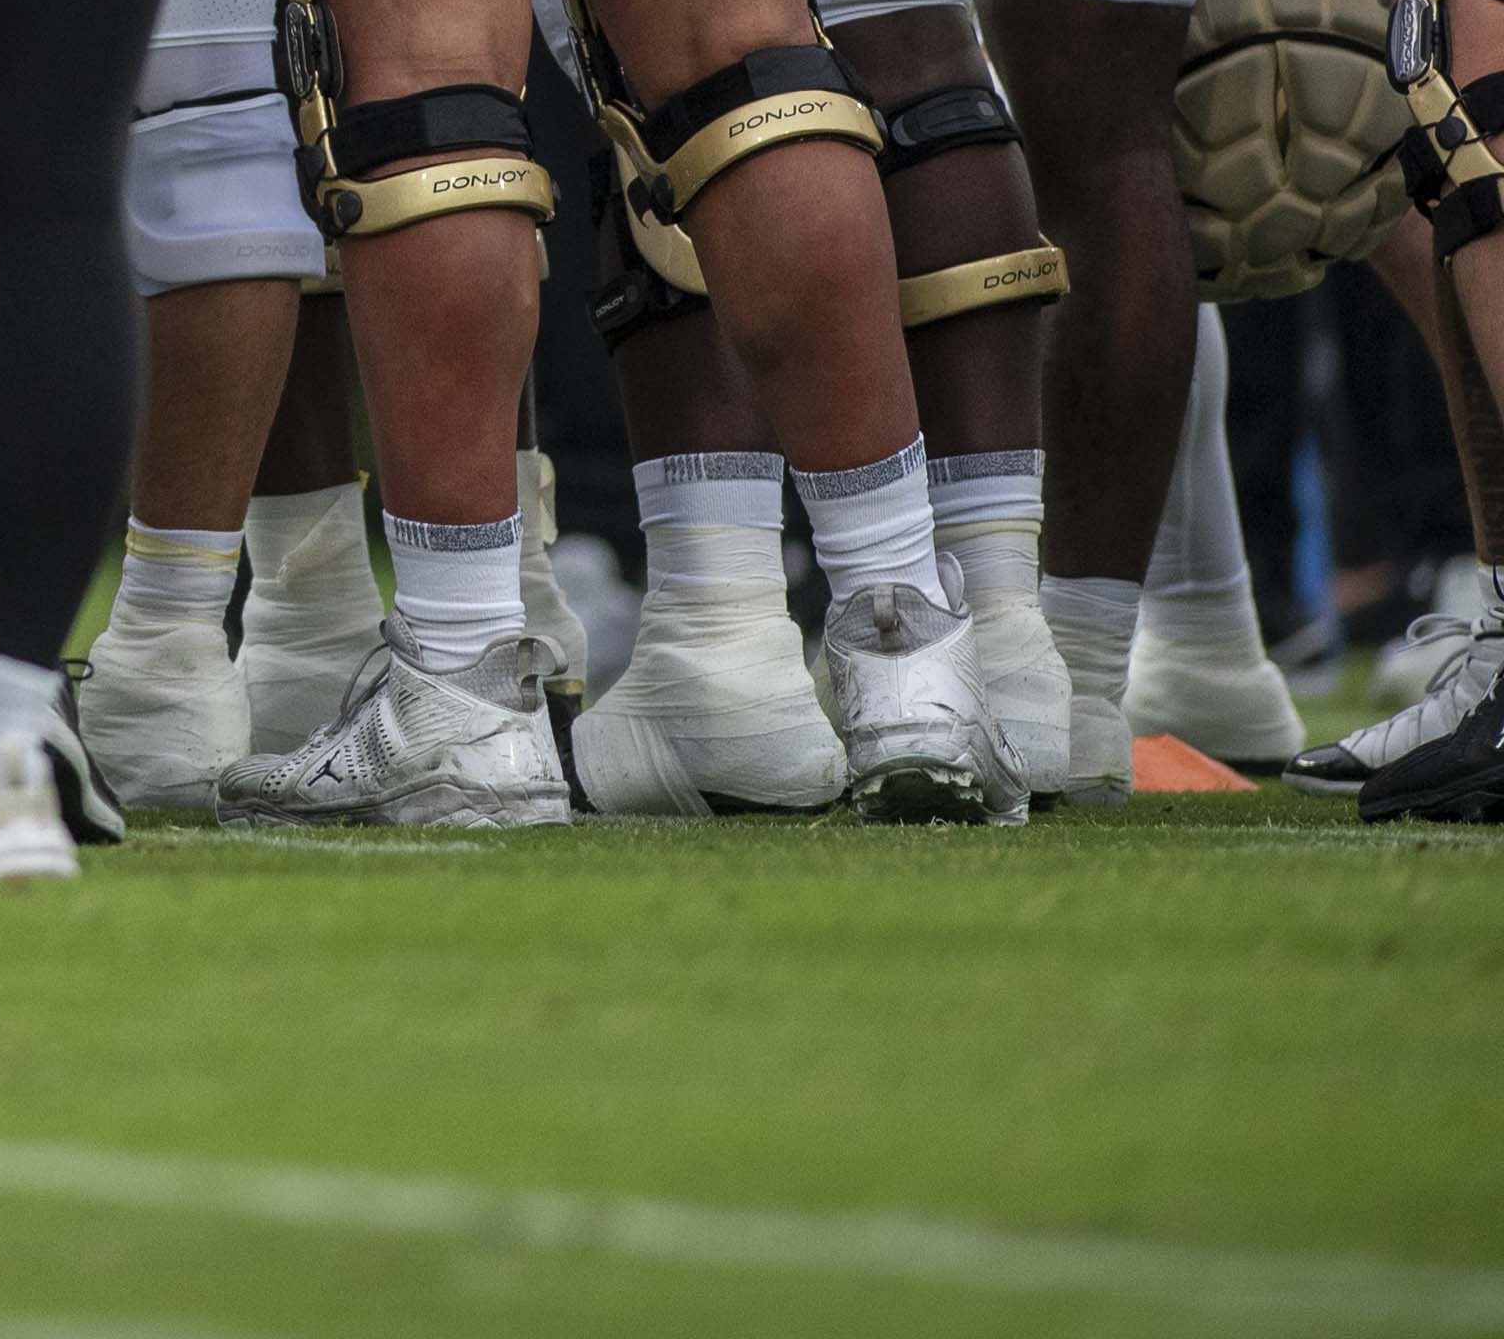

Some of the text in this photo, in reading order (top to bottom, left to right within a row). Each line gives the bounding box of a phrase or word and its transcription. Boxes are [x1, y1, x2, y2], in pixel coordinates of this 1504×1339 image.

[728, 101, 831, 138] DONJOY
[432, 170, 529, 194] DONJOY
[984, 261, 1060, 289] DONJOY
